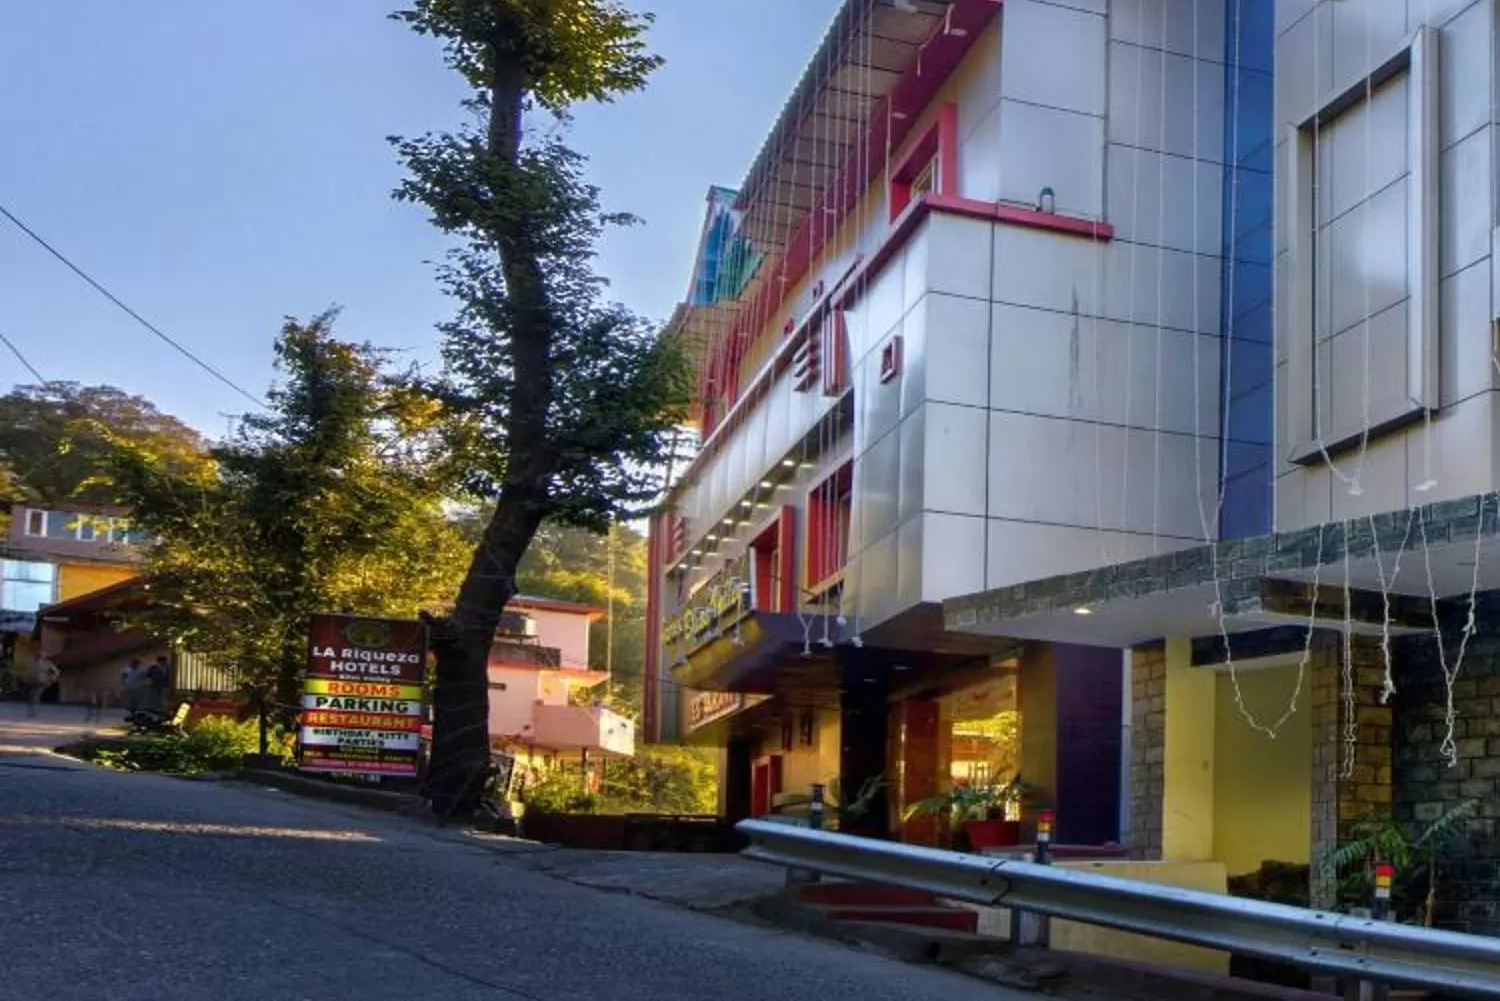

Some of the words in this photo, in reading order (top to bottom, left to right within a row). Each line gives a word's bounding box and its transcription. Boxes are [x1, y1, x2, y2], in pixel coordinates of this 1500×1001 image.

[312, 646, 336, 658] LA
[341, 648, 420, 664] Riqueza
[329, 660, 401, 675] HOTELS
[327, 681, 401, 697] ROOMS
[315, 697, 410, 713] PARKING
[307, 712, 417, 729] RESTAURANT
